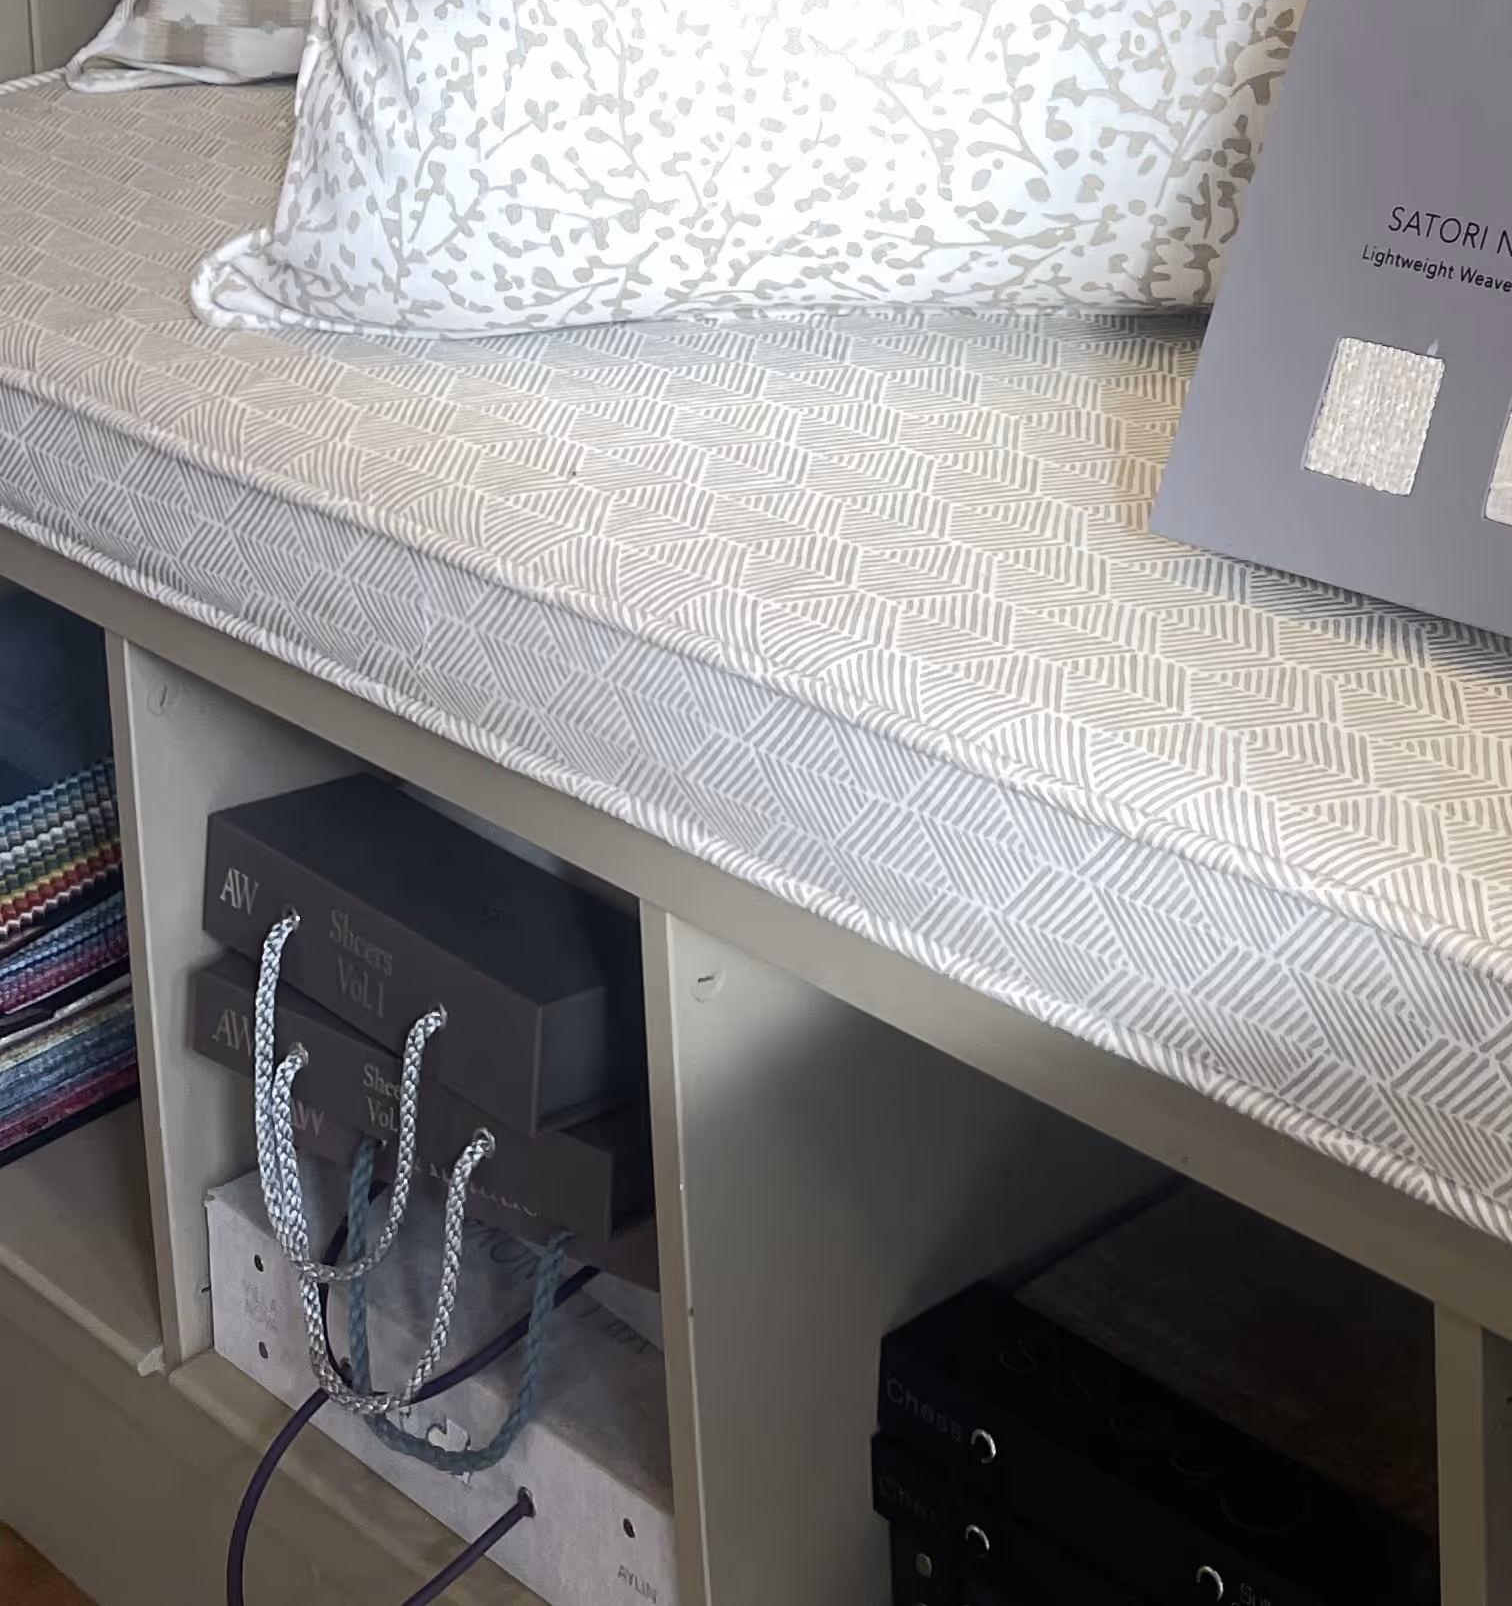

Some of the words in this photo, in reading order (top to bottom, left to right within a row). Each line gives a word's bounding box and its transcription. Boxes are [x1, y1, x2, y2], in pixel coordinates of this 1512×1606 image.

[1387, 205, 1489, 251] SATORI
[1361, 243, 1455, 280] Lightweight
[219, 867, 260, 915] AW
